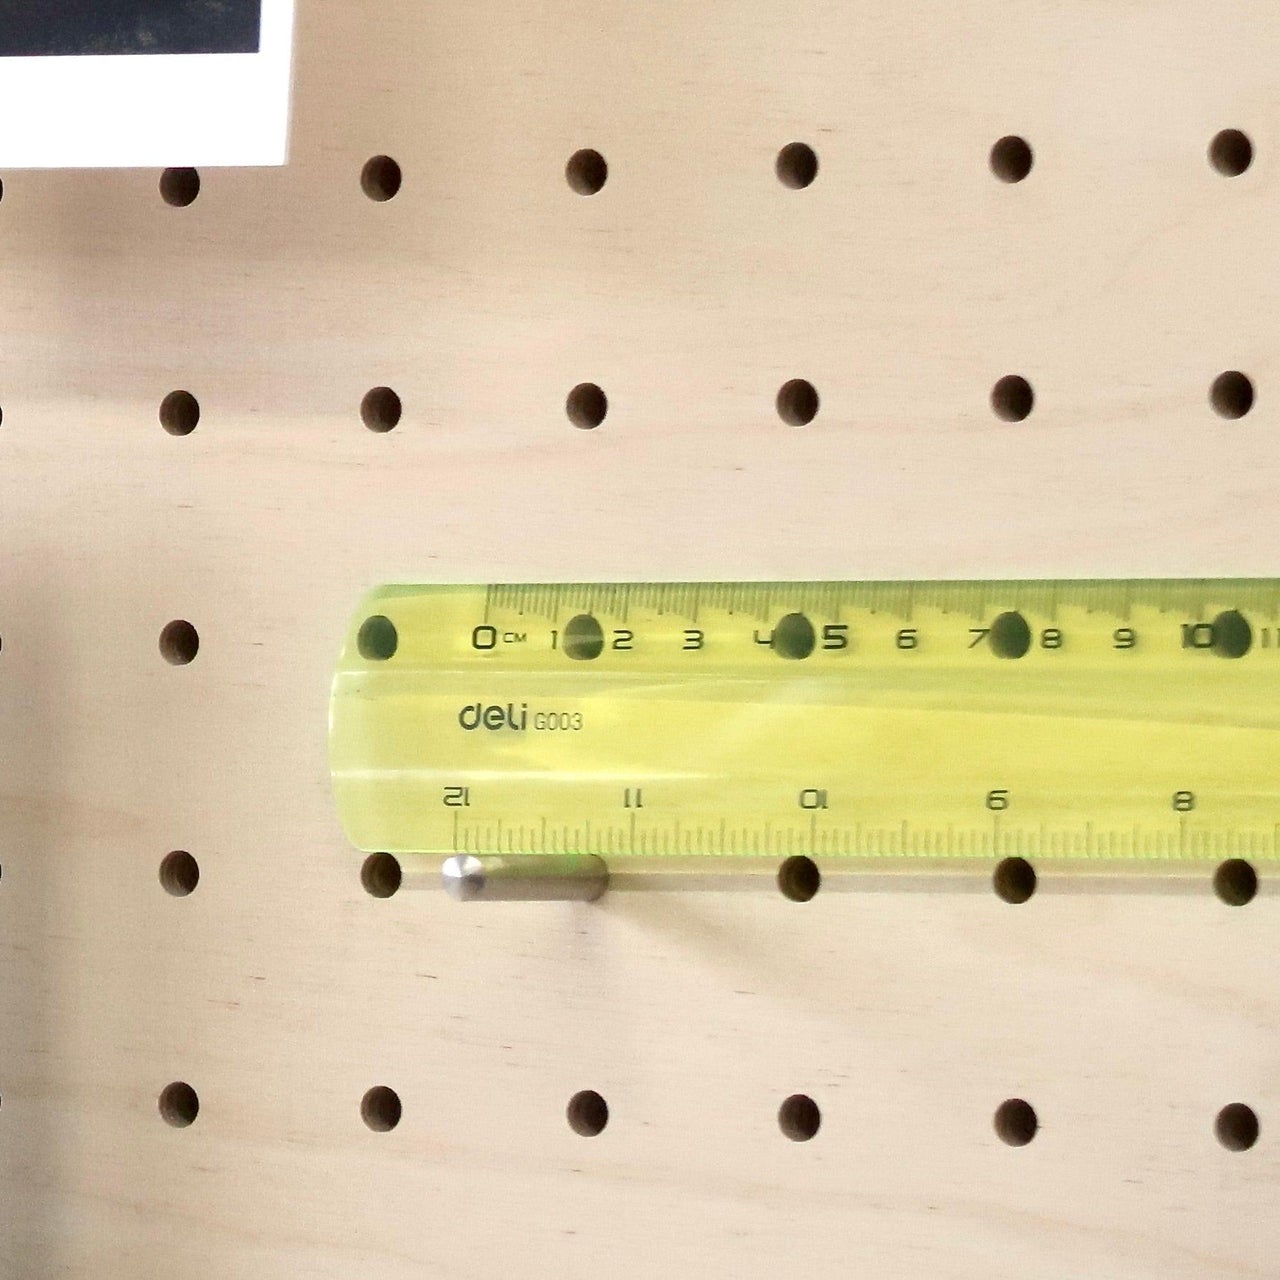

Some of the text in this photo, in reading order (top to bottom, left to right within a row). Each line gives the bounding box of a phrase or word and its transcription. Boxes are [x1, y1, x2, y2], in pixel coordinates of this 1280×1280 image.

[472, 625, 497, 650] 0
[550, 629, 559, 650] 1
[612, 629, 634, 650] 2
[682, 629, 705, 650] 3
[752, 629, 777, 650] 4
[822, 624, 848, 650] 5
[896, 628, 919, 650] 6
[967, 628, 992, 649] 7
[1041, 628, 1063, 649] 8
[1112, 628, 1135, 649] 9
[1180, 623, 1216, 649] 10
[458, 702, 584, 731] deli G003
[623, 787, 644, 809] 11
[1172, 790, 1196, 813] 8
